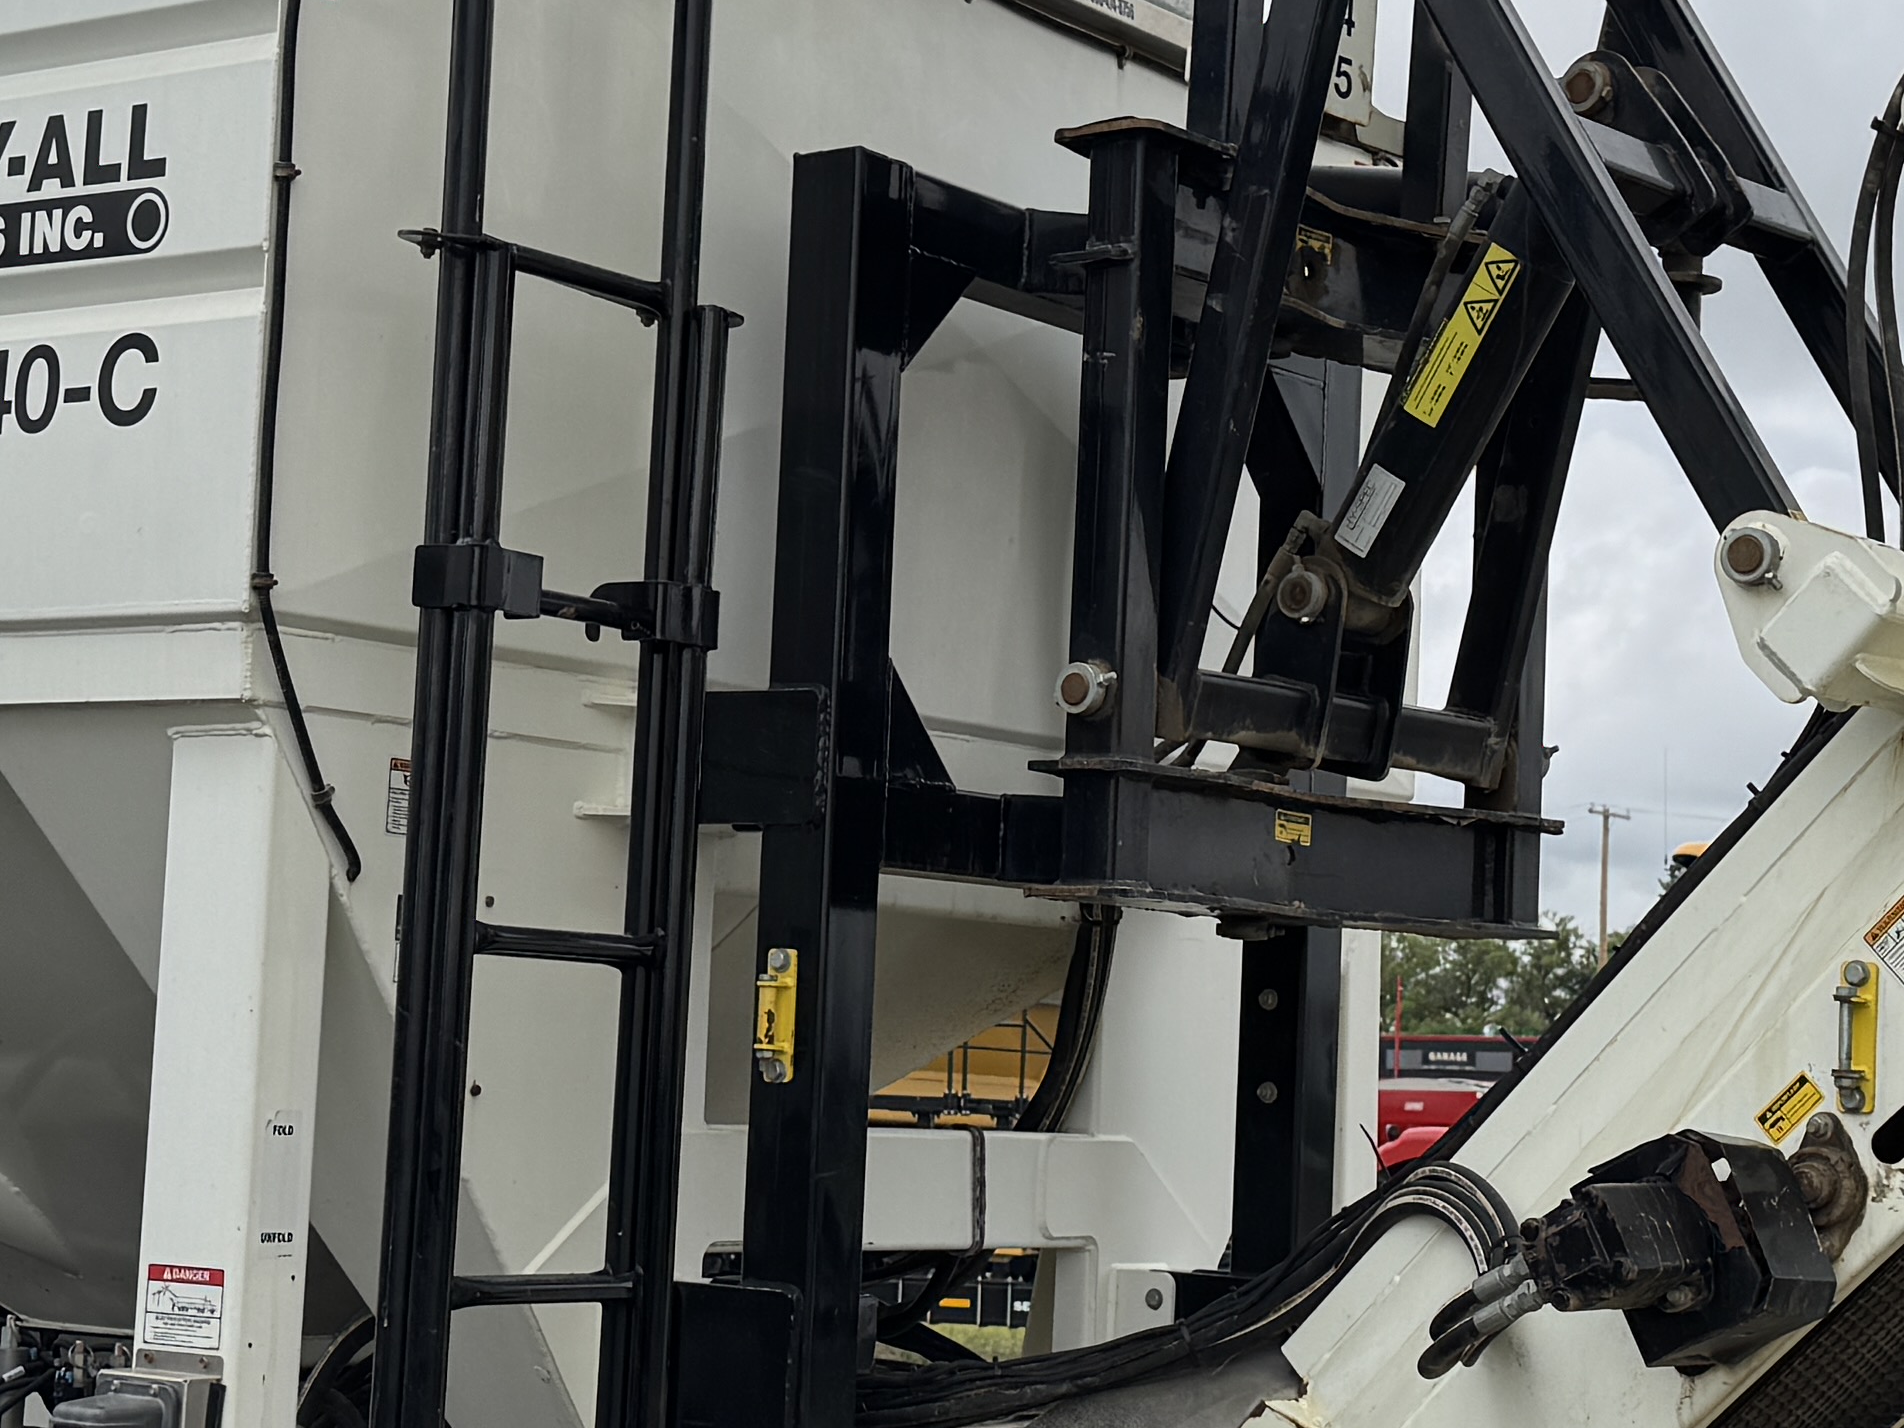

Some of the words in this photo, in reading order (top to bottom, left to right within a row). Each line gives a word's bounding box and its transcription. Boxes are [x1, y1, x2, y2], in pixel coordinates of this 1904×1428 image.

[1334, 55, 1353, 99] 5
[19, 205, 104, 256] INC.
[272, 1124, 294, 1136] FOLD
[260, 1232, 294, 1243] UNFOLD
[172, 1267, 210, 1281] DANGER
